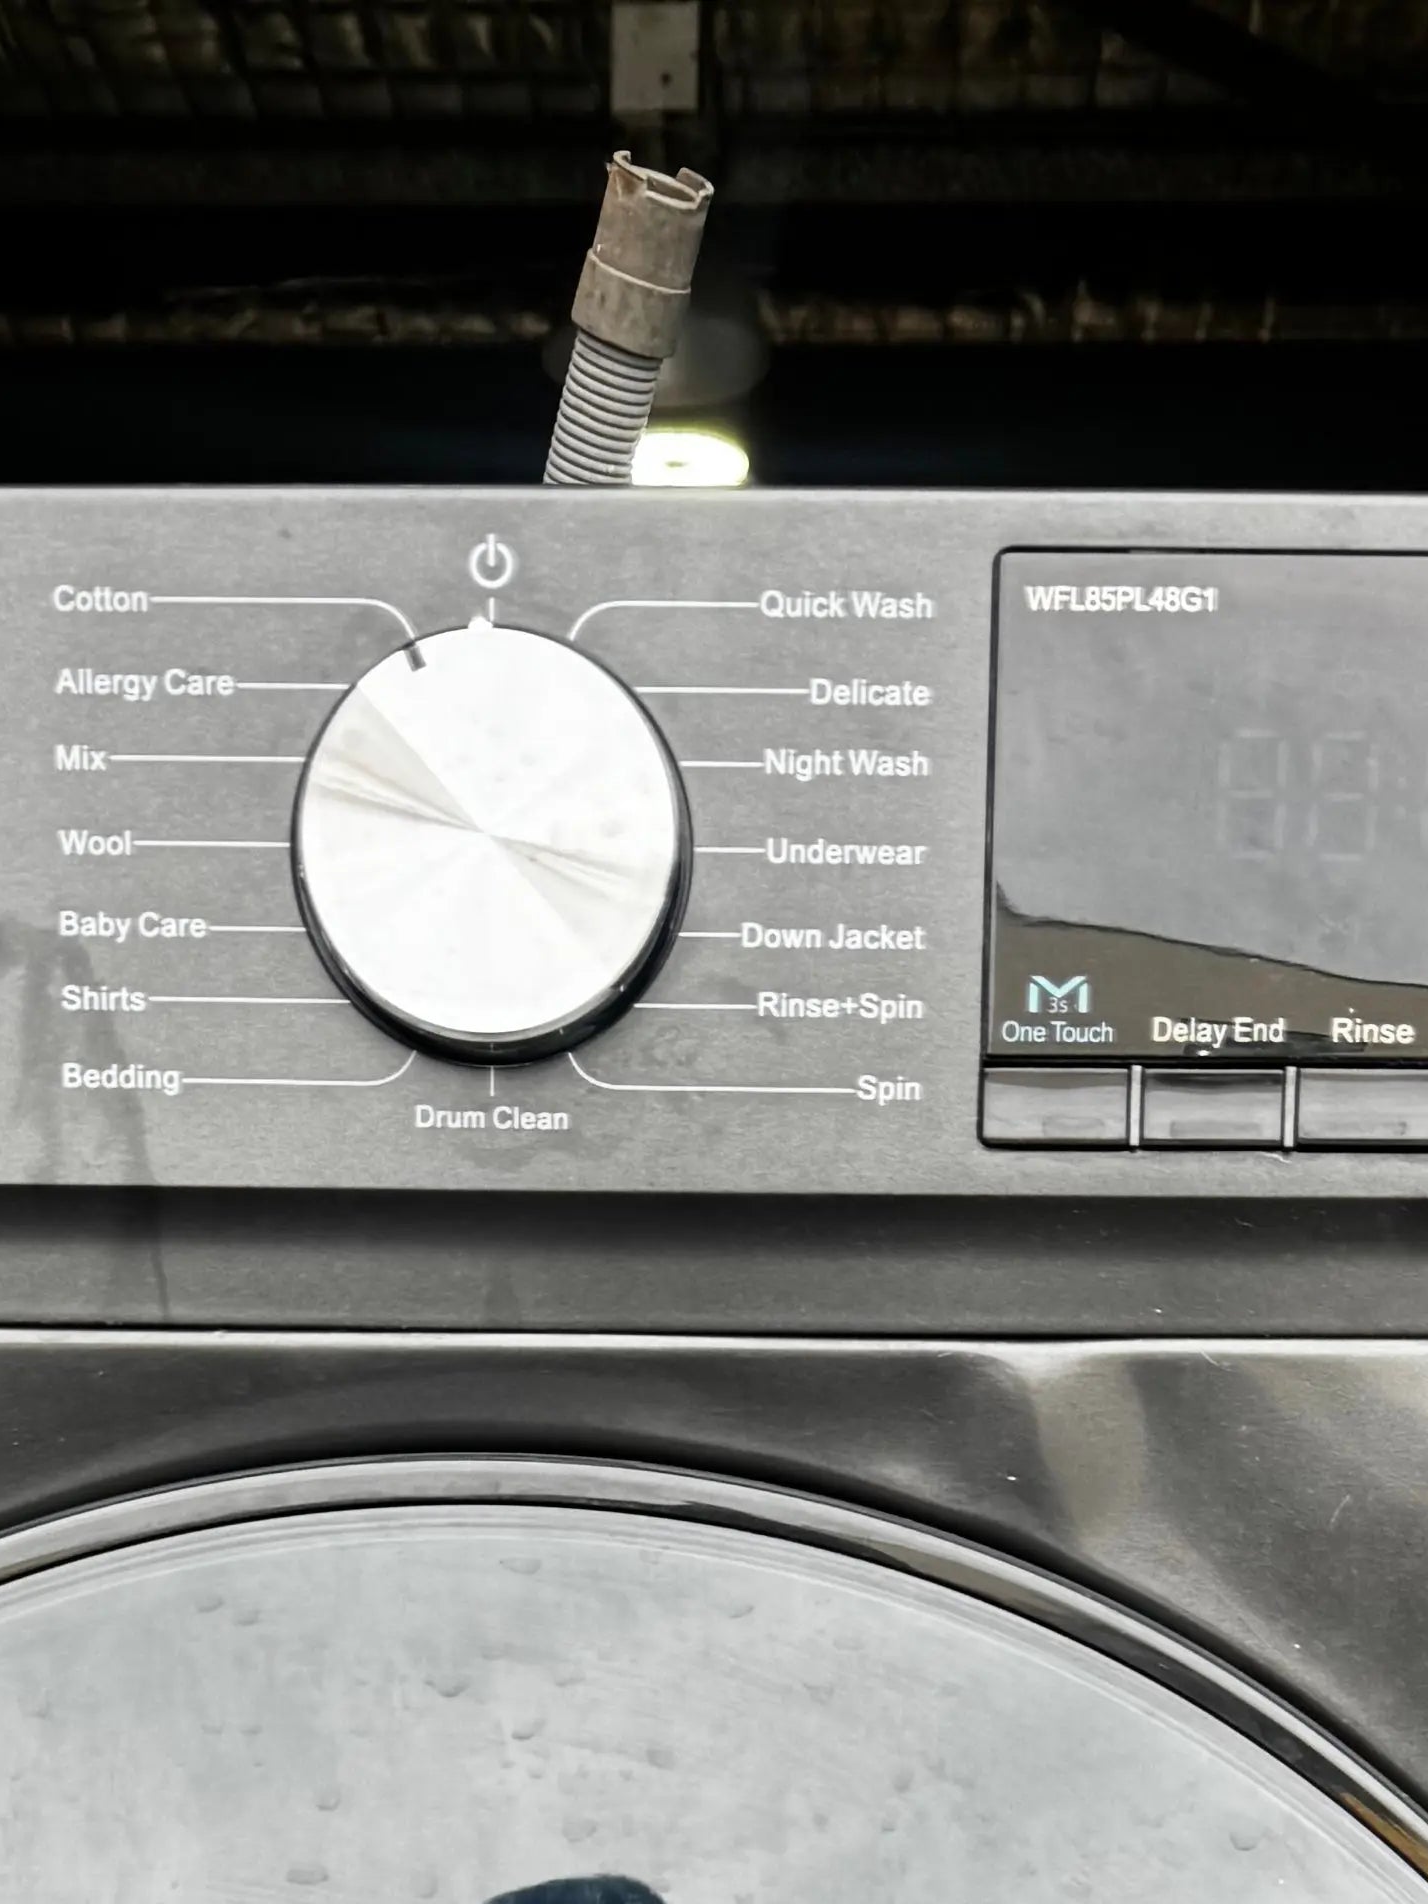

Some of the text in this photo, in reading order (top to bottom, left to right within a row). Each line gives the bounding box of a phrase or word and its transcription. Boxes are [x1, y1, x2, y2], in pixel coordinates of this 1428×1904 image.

[53, 584, 148, 612] Cotton
[760, 589, 933, 619] Quick Wash
[1025, 585, 1218, 613] WFL85PL48G1
[55, 667, 237, 702] Allergy Care
[810, 678, 931, 706] Delicate
[56, 744, 106, 771] Mix
[764, 748, 929, 782] Night Wash
[57, 829, 131, 856] Wool
[766, 837, 928, 865] Underwear
[59, 910, 208, 944] Baby Care
[738, 922, 927, 950] Down Jacket
[61, 984, 147, 1012] Shirts
[755, 991, 925, 1025] Rinse+Spin
[1001, 1020, 1114, 1043] One Touch
[1151, 1015, 1285, 1047] Delay End
[1331, 1017, 1415, 1045] Rinse
[62, 1062, 181, 1097] Bedding
[855, 1074, 922, 1107] Spin
[414, 1104, 569, 1131] Drum Clean
